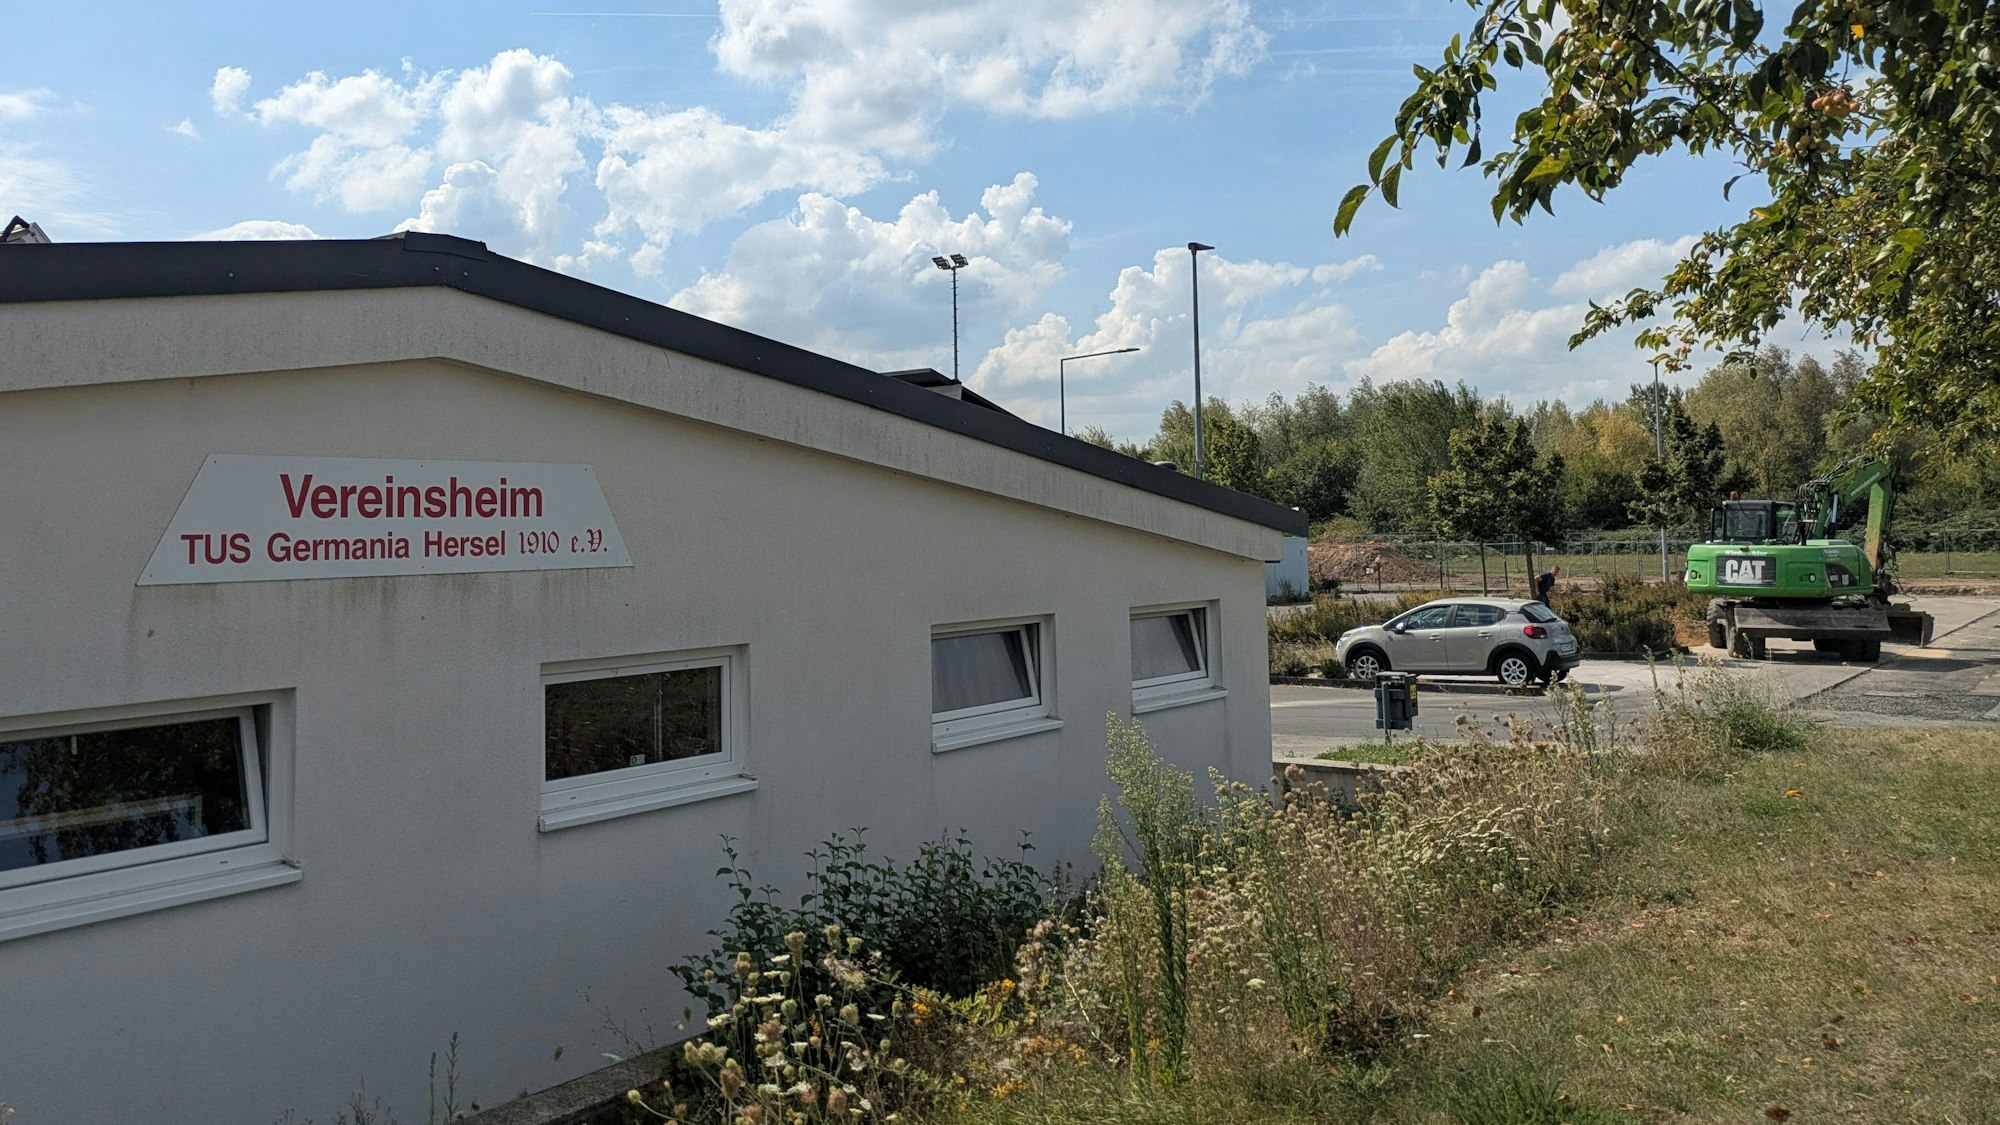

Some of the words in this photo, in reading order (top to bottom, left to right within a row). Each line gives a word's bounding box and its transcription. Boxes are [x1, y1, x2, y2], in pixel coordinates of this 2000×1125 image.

[279, 473, 544, 519] Vereinsheim
[180, 533, 252, 565] TUS
[266, 531, 411, 563] Germania
[423, 530, 506, 557] Hersel
[517, 530, 560, 555] 1910
[570, 528, 609, 554] e.V.
[1725, 559, 1766, 584] CAT
